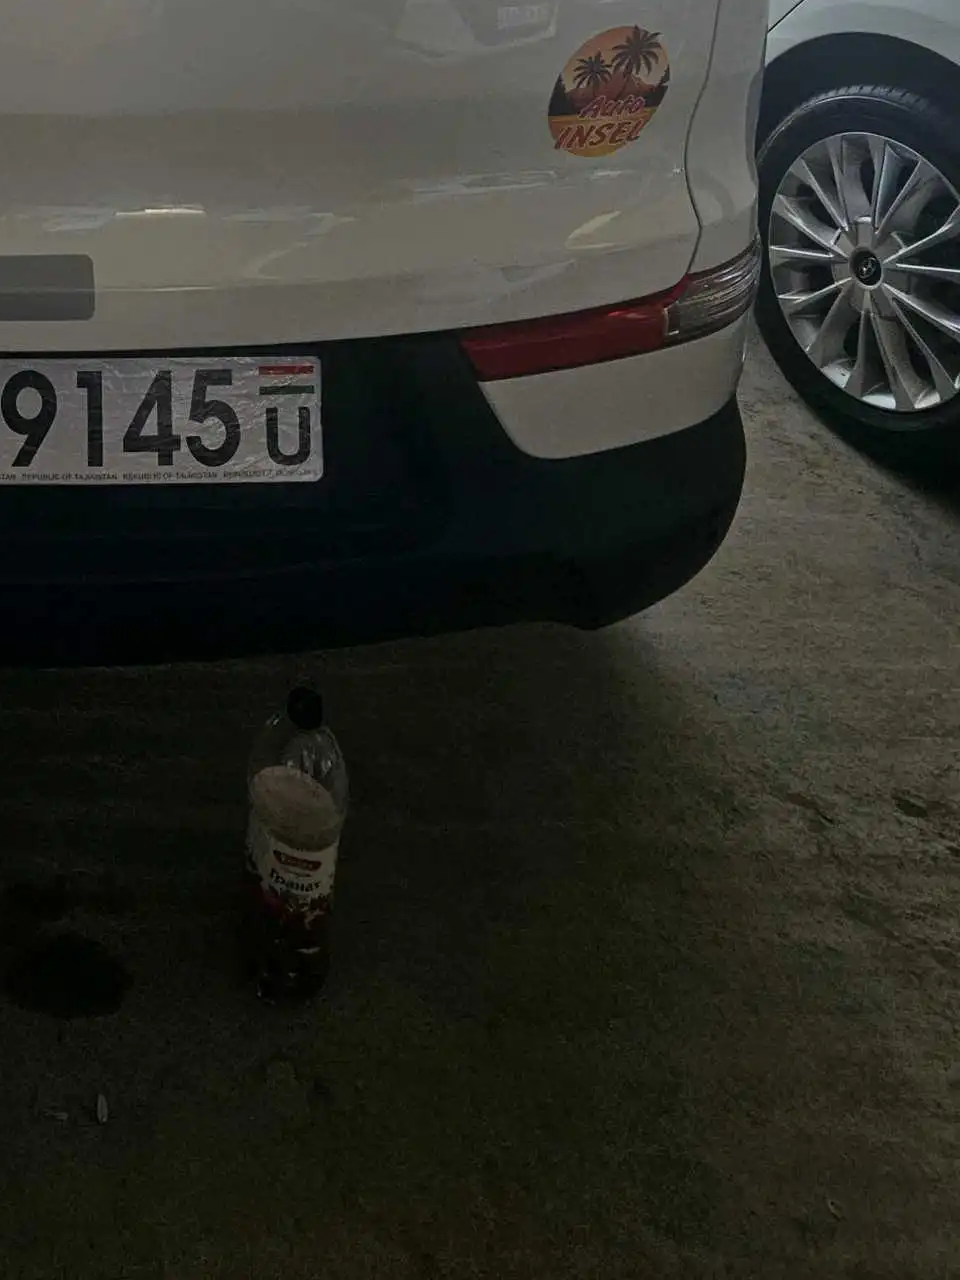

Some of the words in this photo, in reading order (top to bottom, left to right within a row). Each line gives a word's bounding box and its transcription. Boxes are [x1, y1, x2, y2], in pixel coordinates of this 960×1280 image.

[577, 94, 646, 121] Auto
[554, 118, 645, 150] INSEL
[265, 406, 312, 466] U
